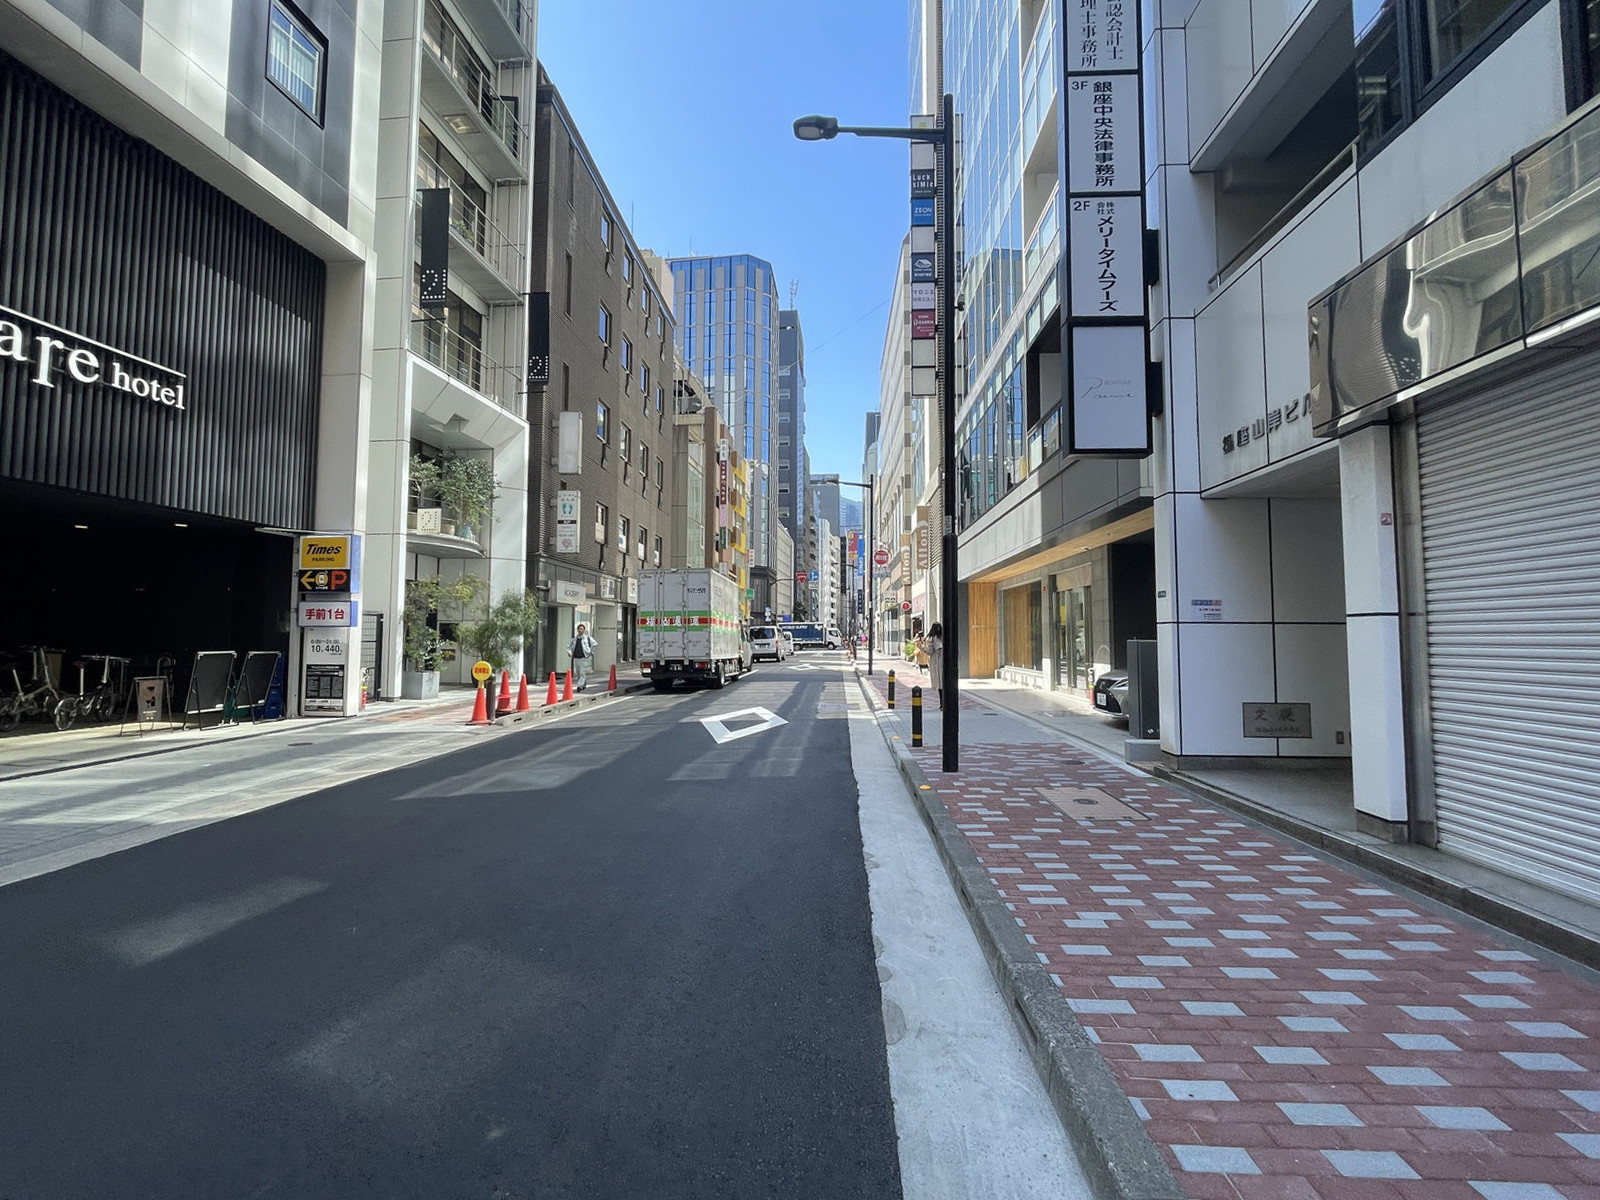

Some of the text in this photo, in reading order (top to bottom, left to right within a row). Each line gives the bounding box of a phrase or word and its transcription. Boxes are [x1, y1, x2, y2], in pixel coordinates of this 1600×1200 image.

[1106, 0, 1123, 60] 認会計士
[1072, 81, 1088, 91] 3F
[1093, 81, 1115, 187] 銀座中央法律事務所
[1073, 201, 1090, 211] 2F
[1098, 216, 1119, 312] メリータイムフーズ
[421, 269, 447, 300] 21
[528, 355, 549, 379] 21
[112, 362, 186, 410] hotel
[306, 543, 342, 555] Times
[305, 608, 345, 620] 手前1台
